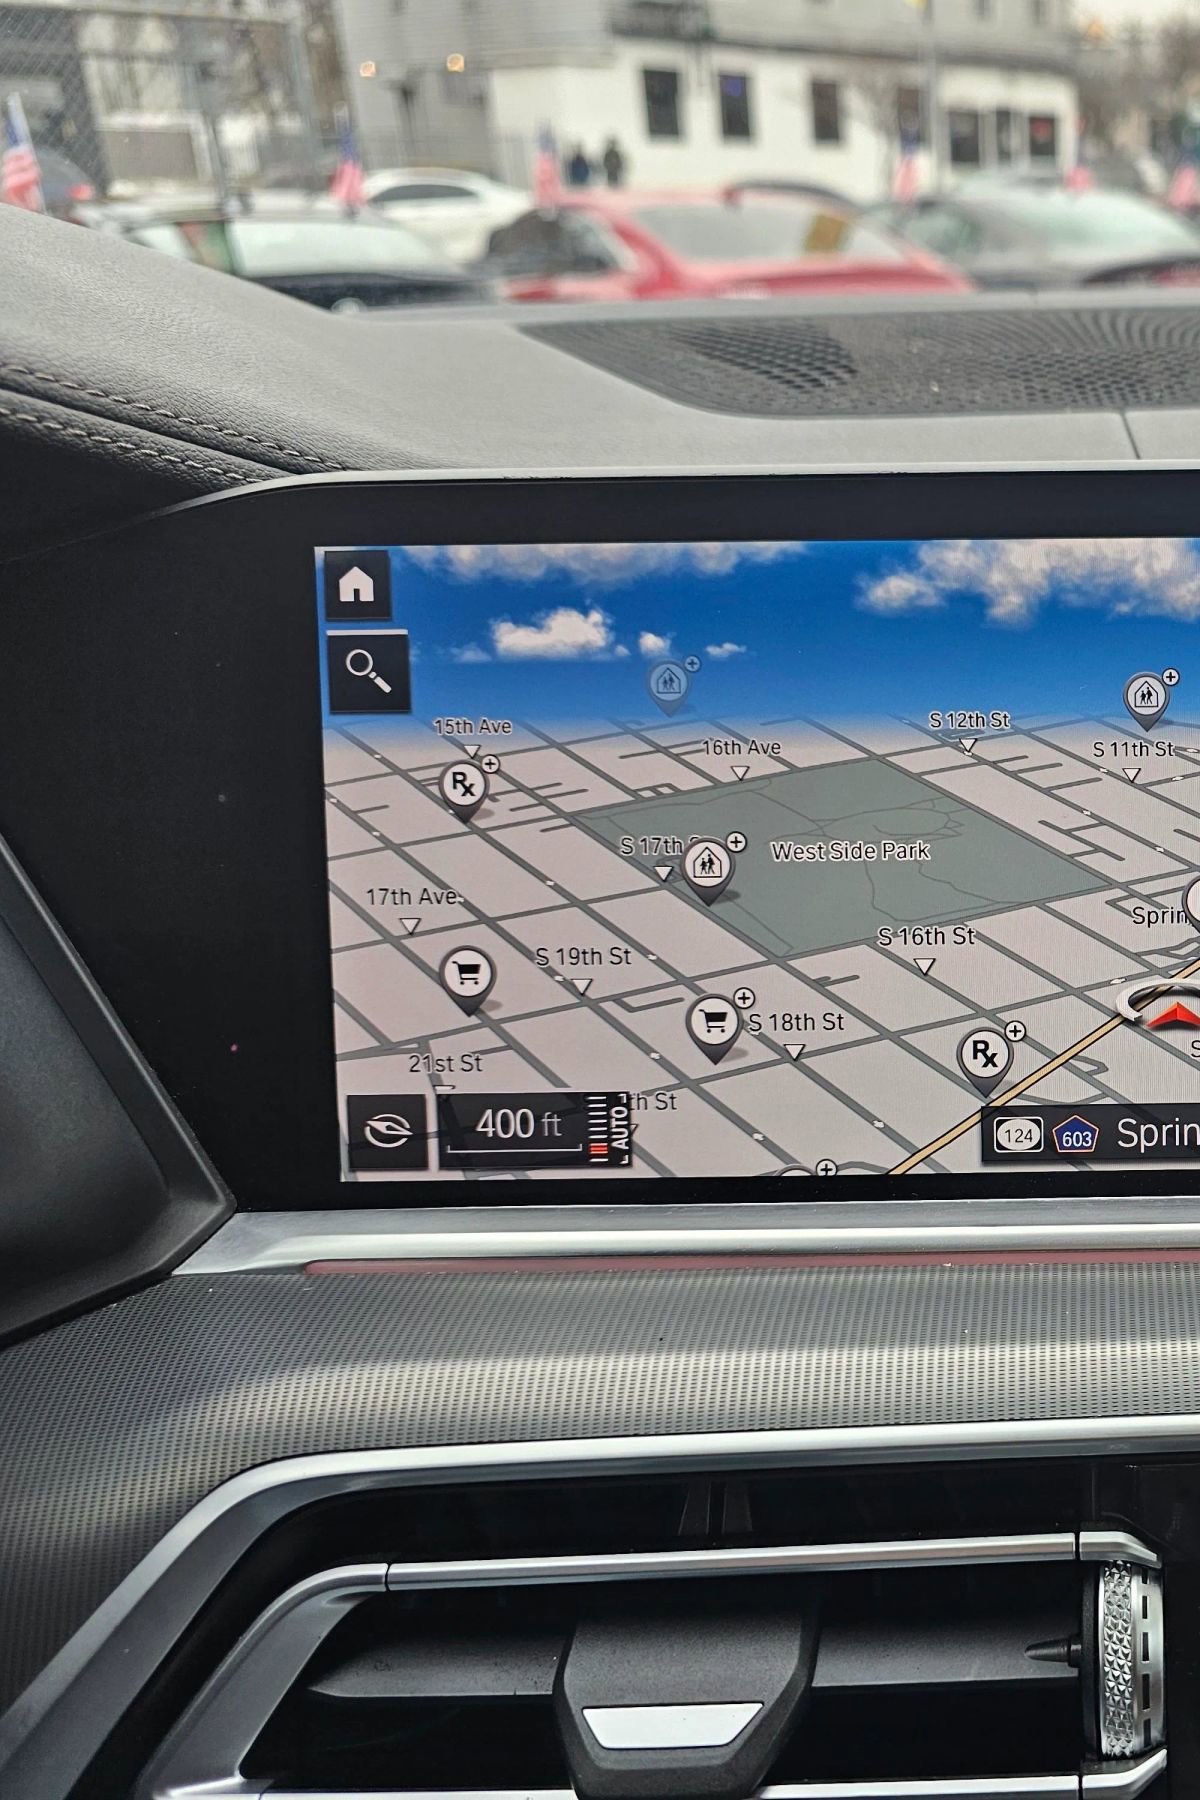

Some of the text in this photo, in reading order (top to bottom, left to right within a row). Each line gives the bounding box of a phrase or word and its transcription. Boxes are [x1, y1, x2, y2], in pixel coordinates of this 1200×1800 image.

[434, 719, 511, 734] 15th Ave
[930, 712, 1009, 728] S 12th St
[703, 740, 781, 755] 16th Ave
[1093, 741, 1173, 756] S 11th St
[621, 838, 633, 854] S
[640, 838, 682, 854] 17th
[772, 843, 929, 860] West Side Park
[367, 889, 456, 905] 17th Ave
[878, 928, 975, 945] S 16th St
[536, 949, 631, 965] S 19th St
[749, 1014, 844, 1030] S 18th St
[409, 1055, 482, 1072] 21st St
[655, 1092, 677, 1110] St
[477, 1110, 562, 1138] 400 ft
[611, 1107, 629, 1149] AUTO
[1004, 1126, 1033, 1143] 124
[1063, 1130, 1092, 1148] 603
